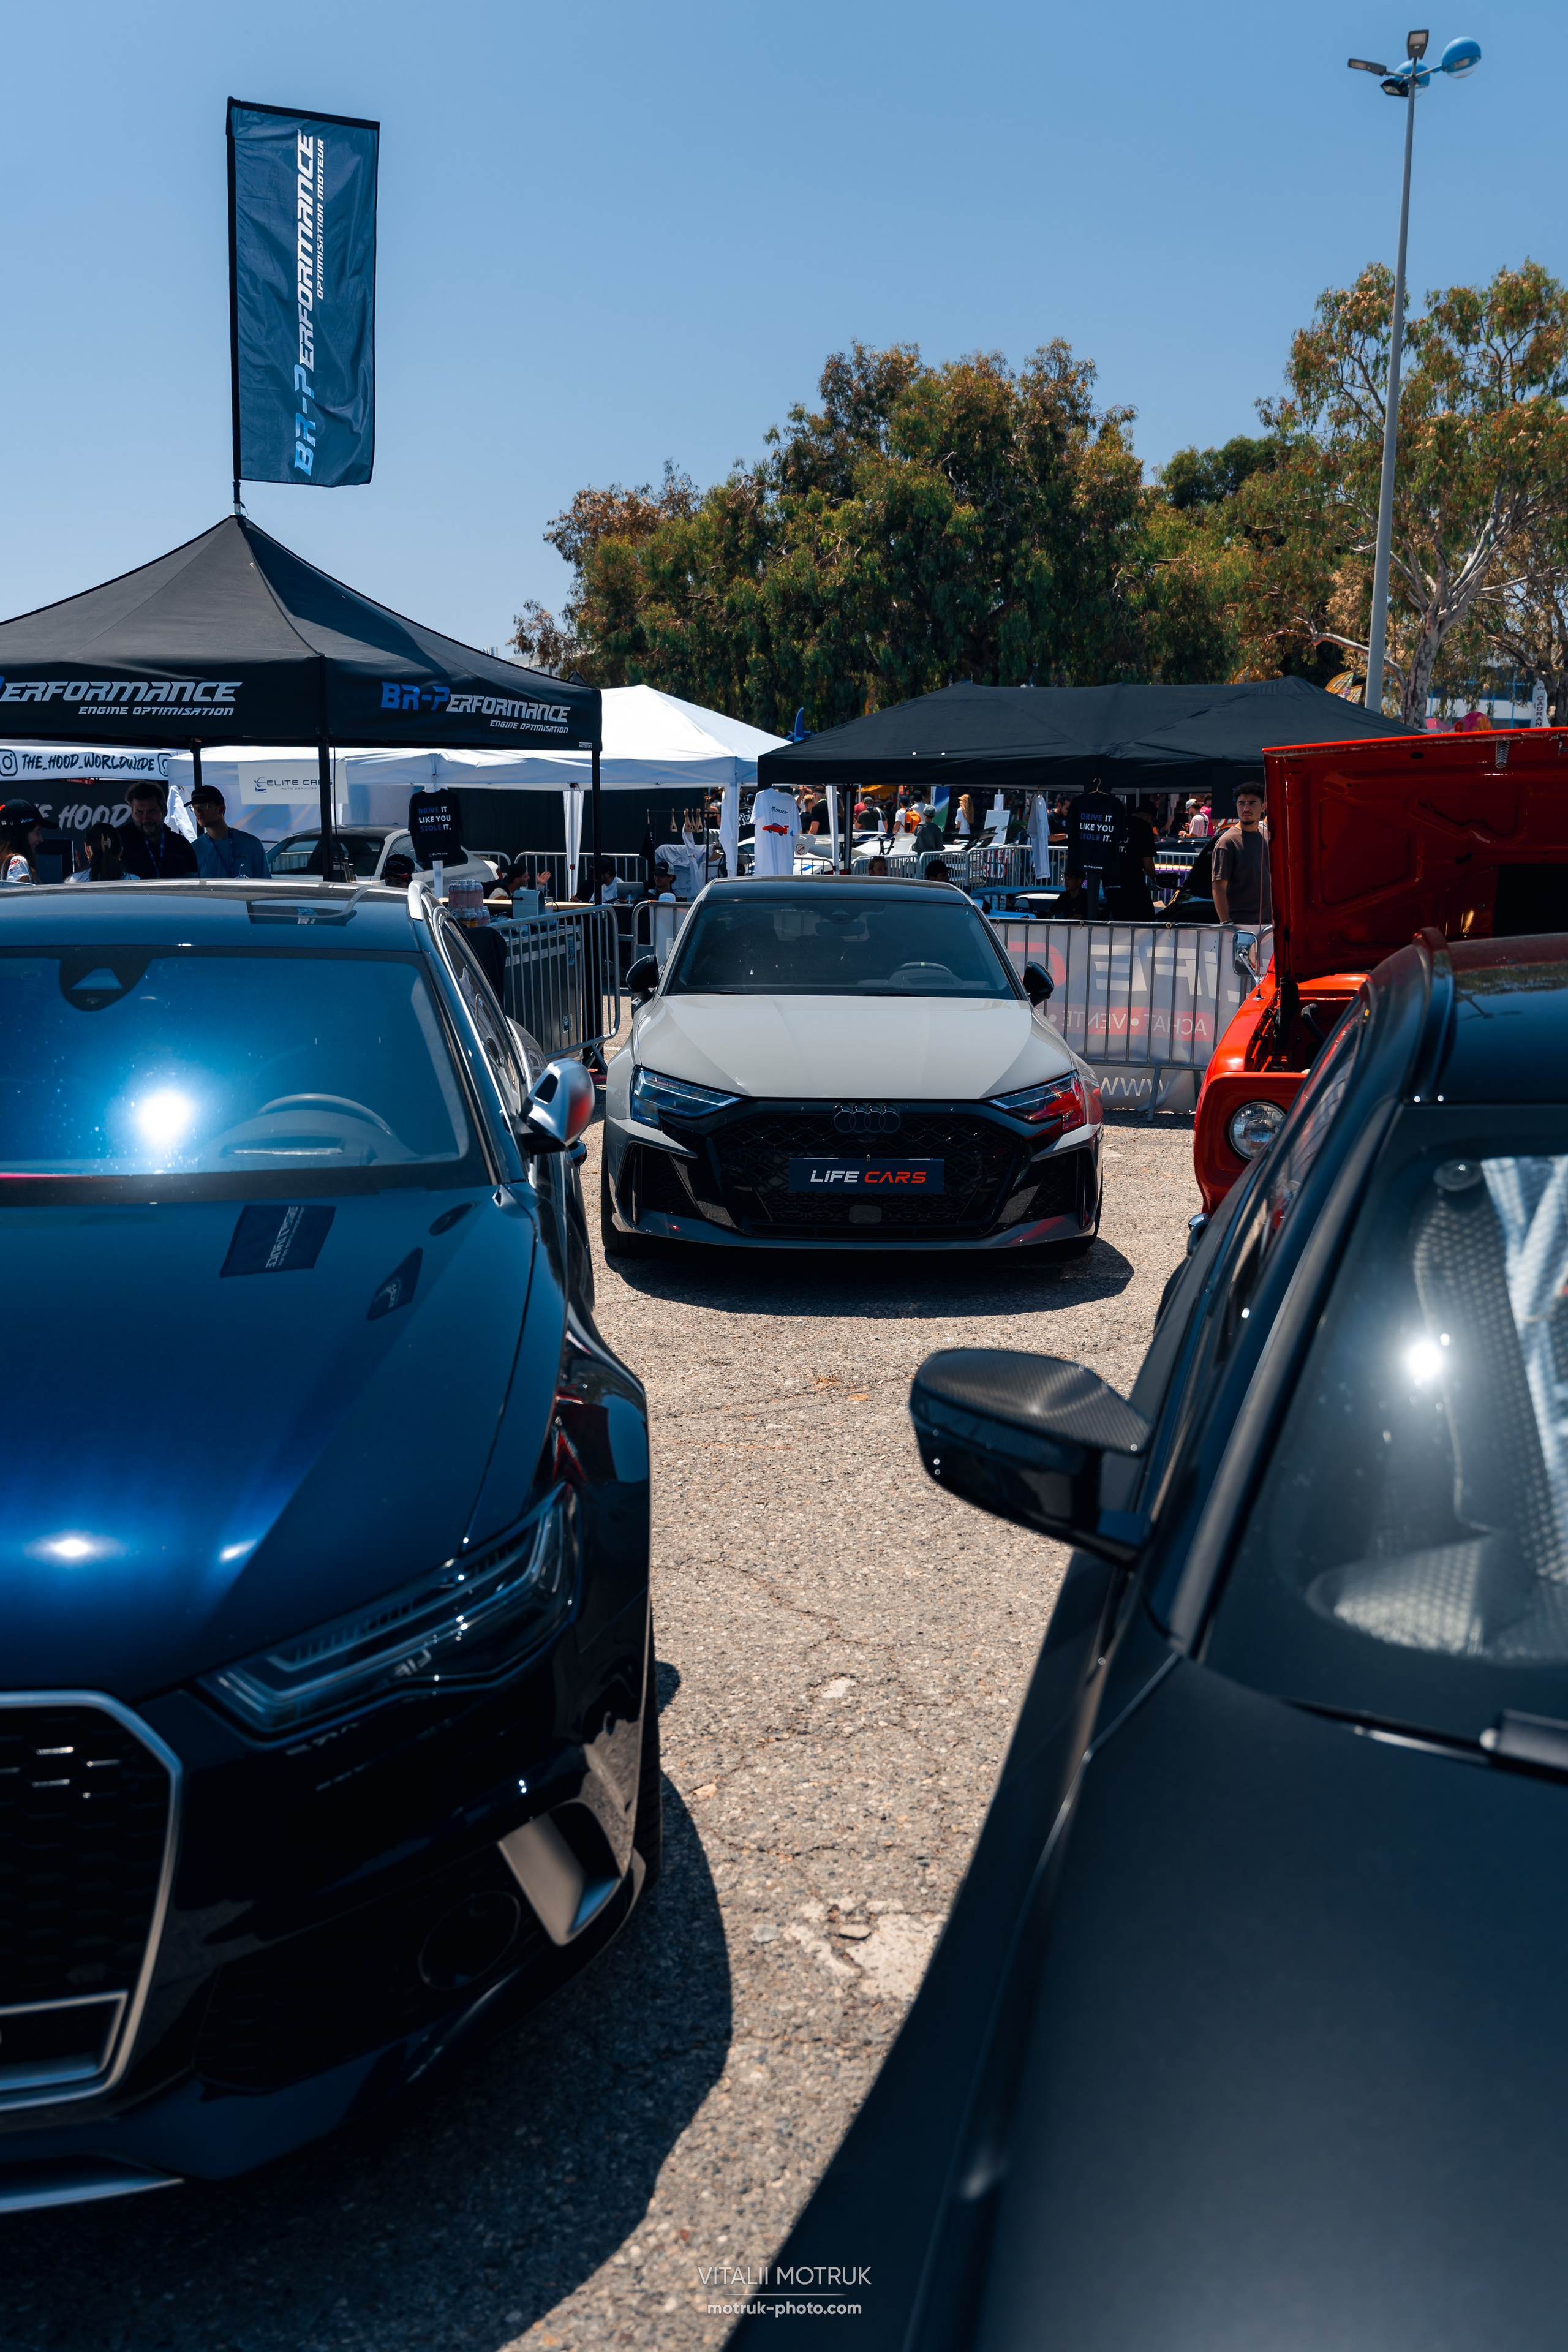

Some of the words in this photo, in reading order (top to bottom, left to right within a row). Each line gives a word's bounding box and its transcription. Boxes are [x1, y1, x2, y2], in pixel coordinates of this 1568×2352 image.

[293, 129, 317, 476] BR-PERFORMANCE
[0, 676, 243, 702] ERFORMANCE
[380, 682, 571, 723] BR-PERFORMANCE
[78, 706, 128, 715] ENGINE
[132, 707, 234, 716] OPTIMISATION
[490, 720, 518, 729] ENGINE
[520, 723, 568, 734] OPTIMISATION
[58, 804, 132, 831] HOOD
[1080, 813, 1102, 821] DRIVE
[1079, 823, 1095, 831] LIKE
[1096, 824, 1114, 832] YOU
[810, 1170, 860, 1183] LIFE
[864, 1171, 927, 1183] CARS
